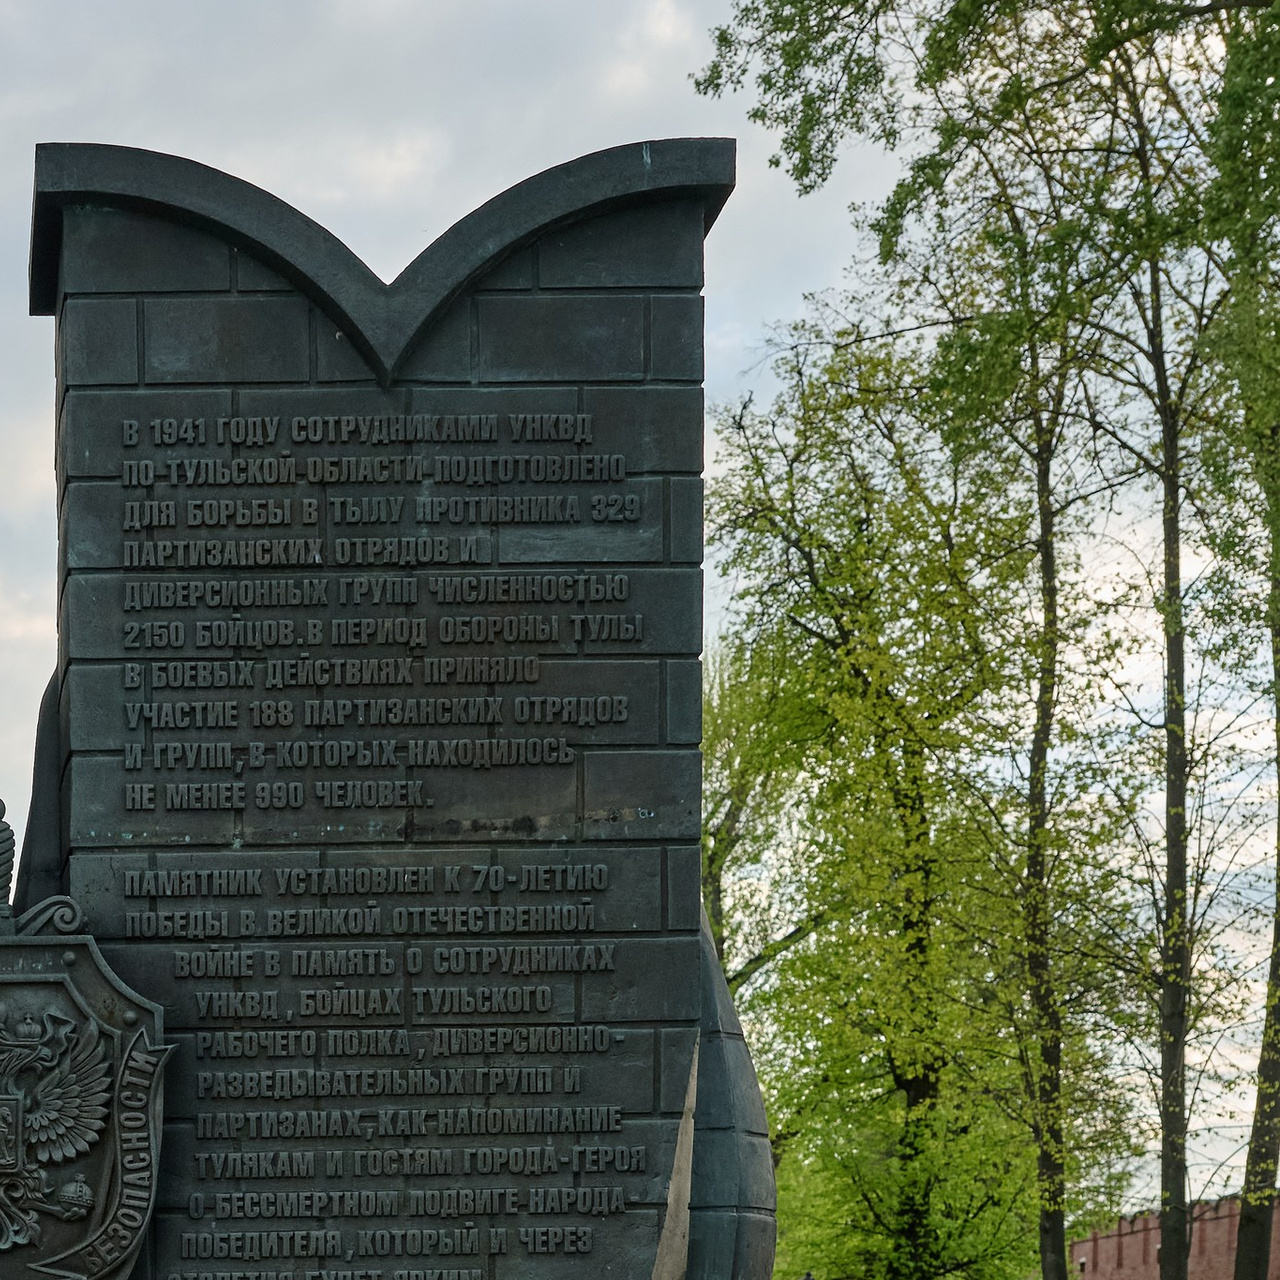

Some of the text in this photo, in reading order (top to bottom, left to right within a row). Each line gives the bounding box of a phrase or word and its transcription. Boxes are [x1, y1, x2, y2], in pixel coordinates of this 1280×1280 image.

[122, 414, 592, 446] В 1941 ГОДУ СОТРУДНИКАМИ УНКВД
[122, 450, 625, 486] ПО ТУЛЬСКОЙ ОБЛАСТИ ПОДГОТОВЛЕНО
[123, 494, 640, 529] ДЛЯ БОРЬБЫ В ТЫЛУ ПРОТИВНИКА 329
[123, 536, 478, 567] ПАРТИЗАНСКИХ ОТРЯДОВ И
[124, 574, 629, 610] ДИВЕРСИОННЫХ ГРУПП ЧИСЛЕННОСТЬЮ
[124, 615, 642, 648] 2150 ПЕРИОД ОБОРОНЫ ТУЛЫ
[124, 653, 539, 689] В БОЕВЫХ ДЕЙСТВИЯХ ПРИНЯЛО
[124, 695, 628, 729] УЧАСТИЕ 188 ПАРТИЗАНСКИХ ОТРЯДОВ
[125, 738, 575, 769] И КОТОРЫХ НАХОДИЛОСЬ
[126, 780, 433, 810] НЕ МЕНЕЕ 990 ЧЕЛОВЕК.
[124, 863, 608, 896] ПАМЯТНИК УСТАНОВЛЕН К 70-ЛЕТИЮ
[125, 898, 595, 939] ПОБЕДЫ В ВЕЛИКОЙ ОТЕЧЕСТВЕННОЙ
[175, 943, 615, 978] ВОЙНЕ В ПАМЯТЬ О СОТРУДНИКАХ
[299, 982, 552, 1018] БОЙЦАХ ТУЛЬСКОГО
[197, 1030, 315, 1058] РАБОЧЕГО
[197, 1066, 581, 1098] РАЗВЕДЫВАТЕЛЬНЫХ ГРУПП И
[438, 1106, 622, 1134] НАПОМИНАНИЕ
[80, 1051, 161, 1276] БЕЗОПАСНОСТИ
[195, 1146, 646, 1179] ТУЛЯКАМ И ГОСТЯМ ГОРОДА-ГЕРОЯ
[189, 1188, 518, 1219] О БЕССМЕРТНОМ ПОДВИГЕ
[490, 1227, 592, 1254] И ЧЕРЕЗ
